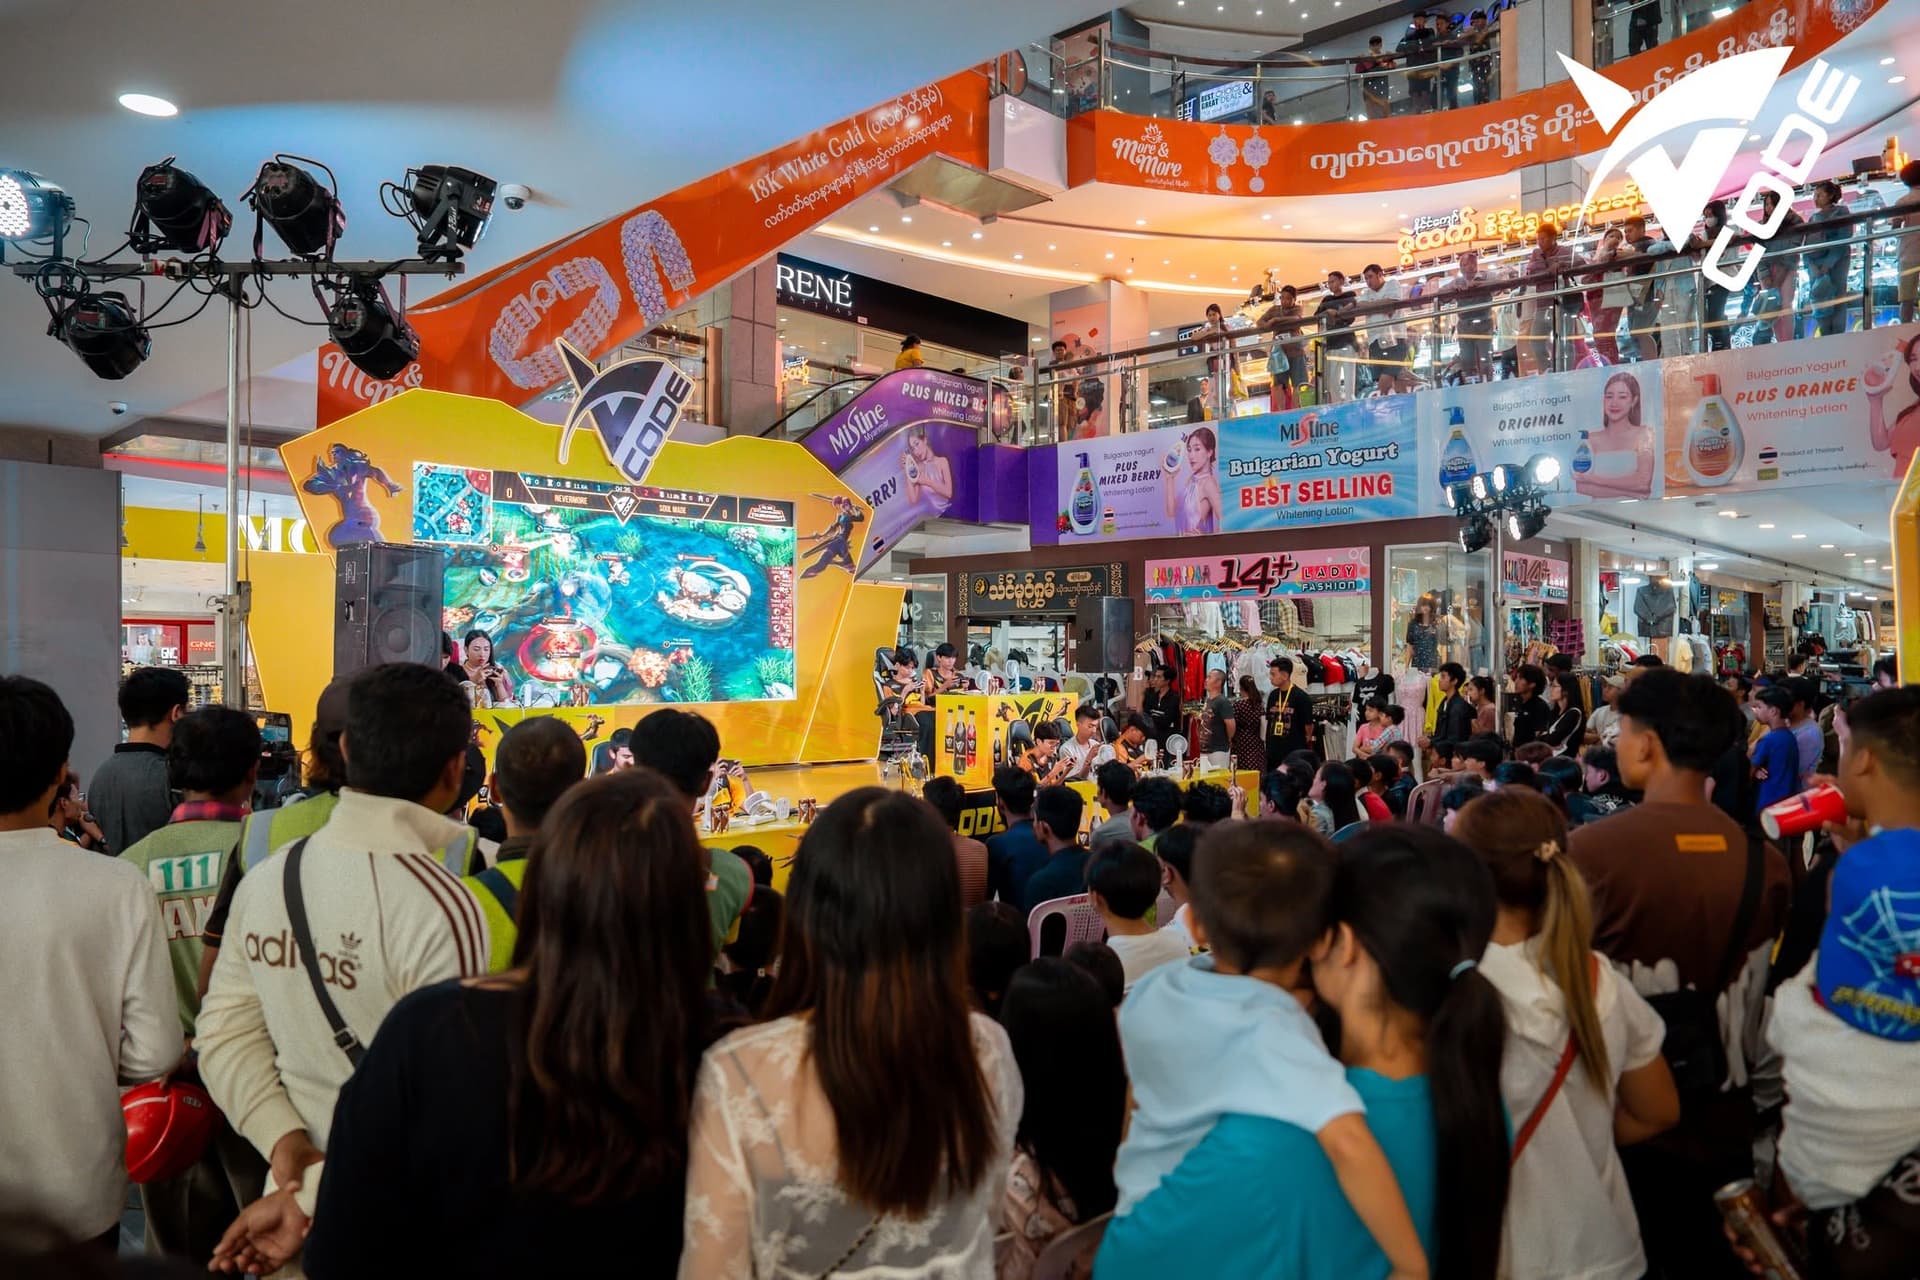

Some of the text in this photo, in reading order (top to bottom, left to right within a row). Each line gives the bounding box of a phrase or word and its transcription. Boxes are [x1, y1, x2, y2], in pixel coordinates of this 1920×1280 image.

[1112, 138, 1169, 165] More &
[748, 170, 784, 203] 18K
[779, 151, 829, 183] White
[828, 124, 865, 158] Gold
[1135, 154, 1182, 178] More
[776, 264, 852, 308] RENÉ
[1746, 359, 1847, 382] Bulgarian Yogurt
[902, 382, 930, 400] PLUS
[934, 389, 968, 408] MIXED
[1735, 377, 1858, 404] PLUS ORANGE
[1492, 395, 1571, 412] Bulgarian Yogurt
[1746, 402, 1848, 422] Whitening Lotion
[622, 371, 692, 481] CODE
[1498, 413, 1565, 431] ORIGINAL
[1492, 431, 1571, 449] Whitening Lotion
[1103, 447, 1154, 461] Bulgarian Yogurt
[1229, 442, 1398, 477] Bulgarian Yogurt
[1099, 469, 1162, 486] MIXED BERRY
[1115, 461, 1138, 472] PLUS
[1103, 485, 1154, 497] Whitening Lotion
[1241, 472, 1393, 509] BEST SELLING
[1276, 505, 1354, 520] Whitening Lotion
[1217, 553, 1298, 597] 14+
[1303, 566, 1355, 579] LADY
[1302, 579, 1357, 592] FASHION
[190, 641, 215, 649] GNC
[158, 855, 209, 890] 111
[244, 930, 357, 990] adias
